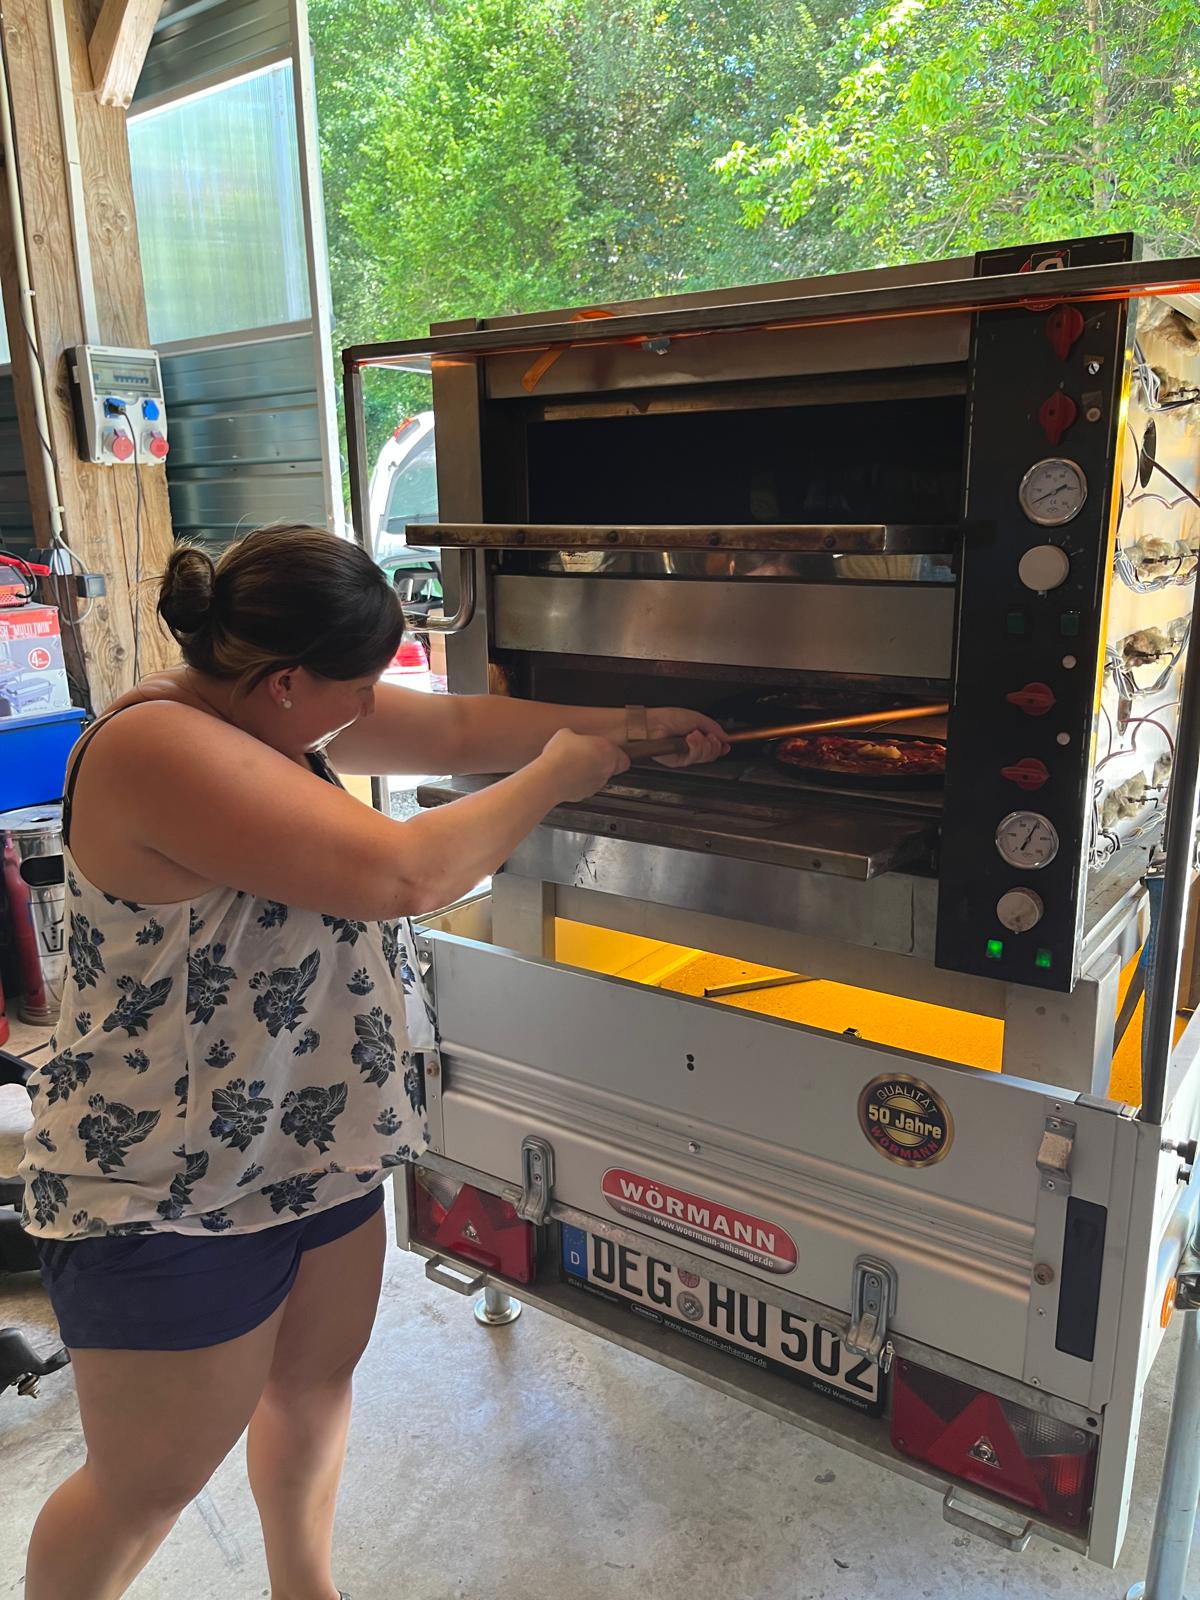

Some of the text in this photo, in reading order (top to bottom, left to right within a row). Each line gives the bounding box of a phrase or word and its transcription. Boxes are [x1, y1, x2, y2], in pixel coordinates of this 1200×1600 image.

[868, 1103, 942, 1140] 50 Jahre
[618, 1178, 776, 1253] WÖRMANN
[653, 1215, 774, 1268] www.woermann-anhaenger.de
[571, 1251, 580, 1265] D
[592, 1233, 873, 1393] DEG HU 502
